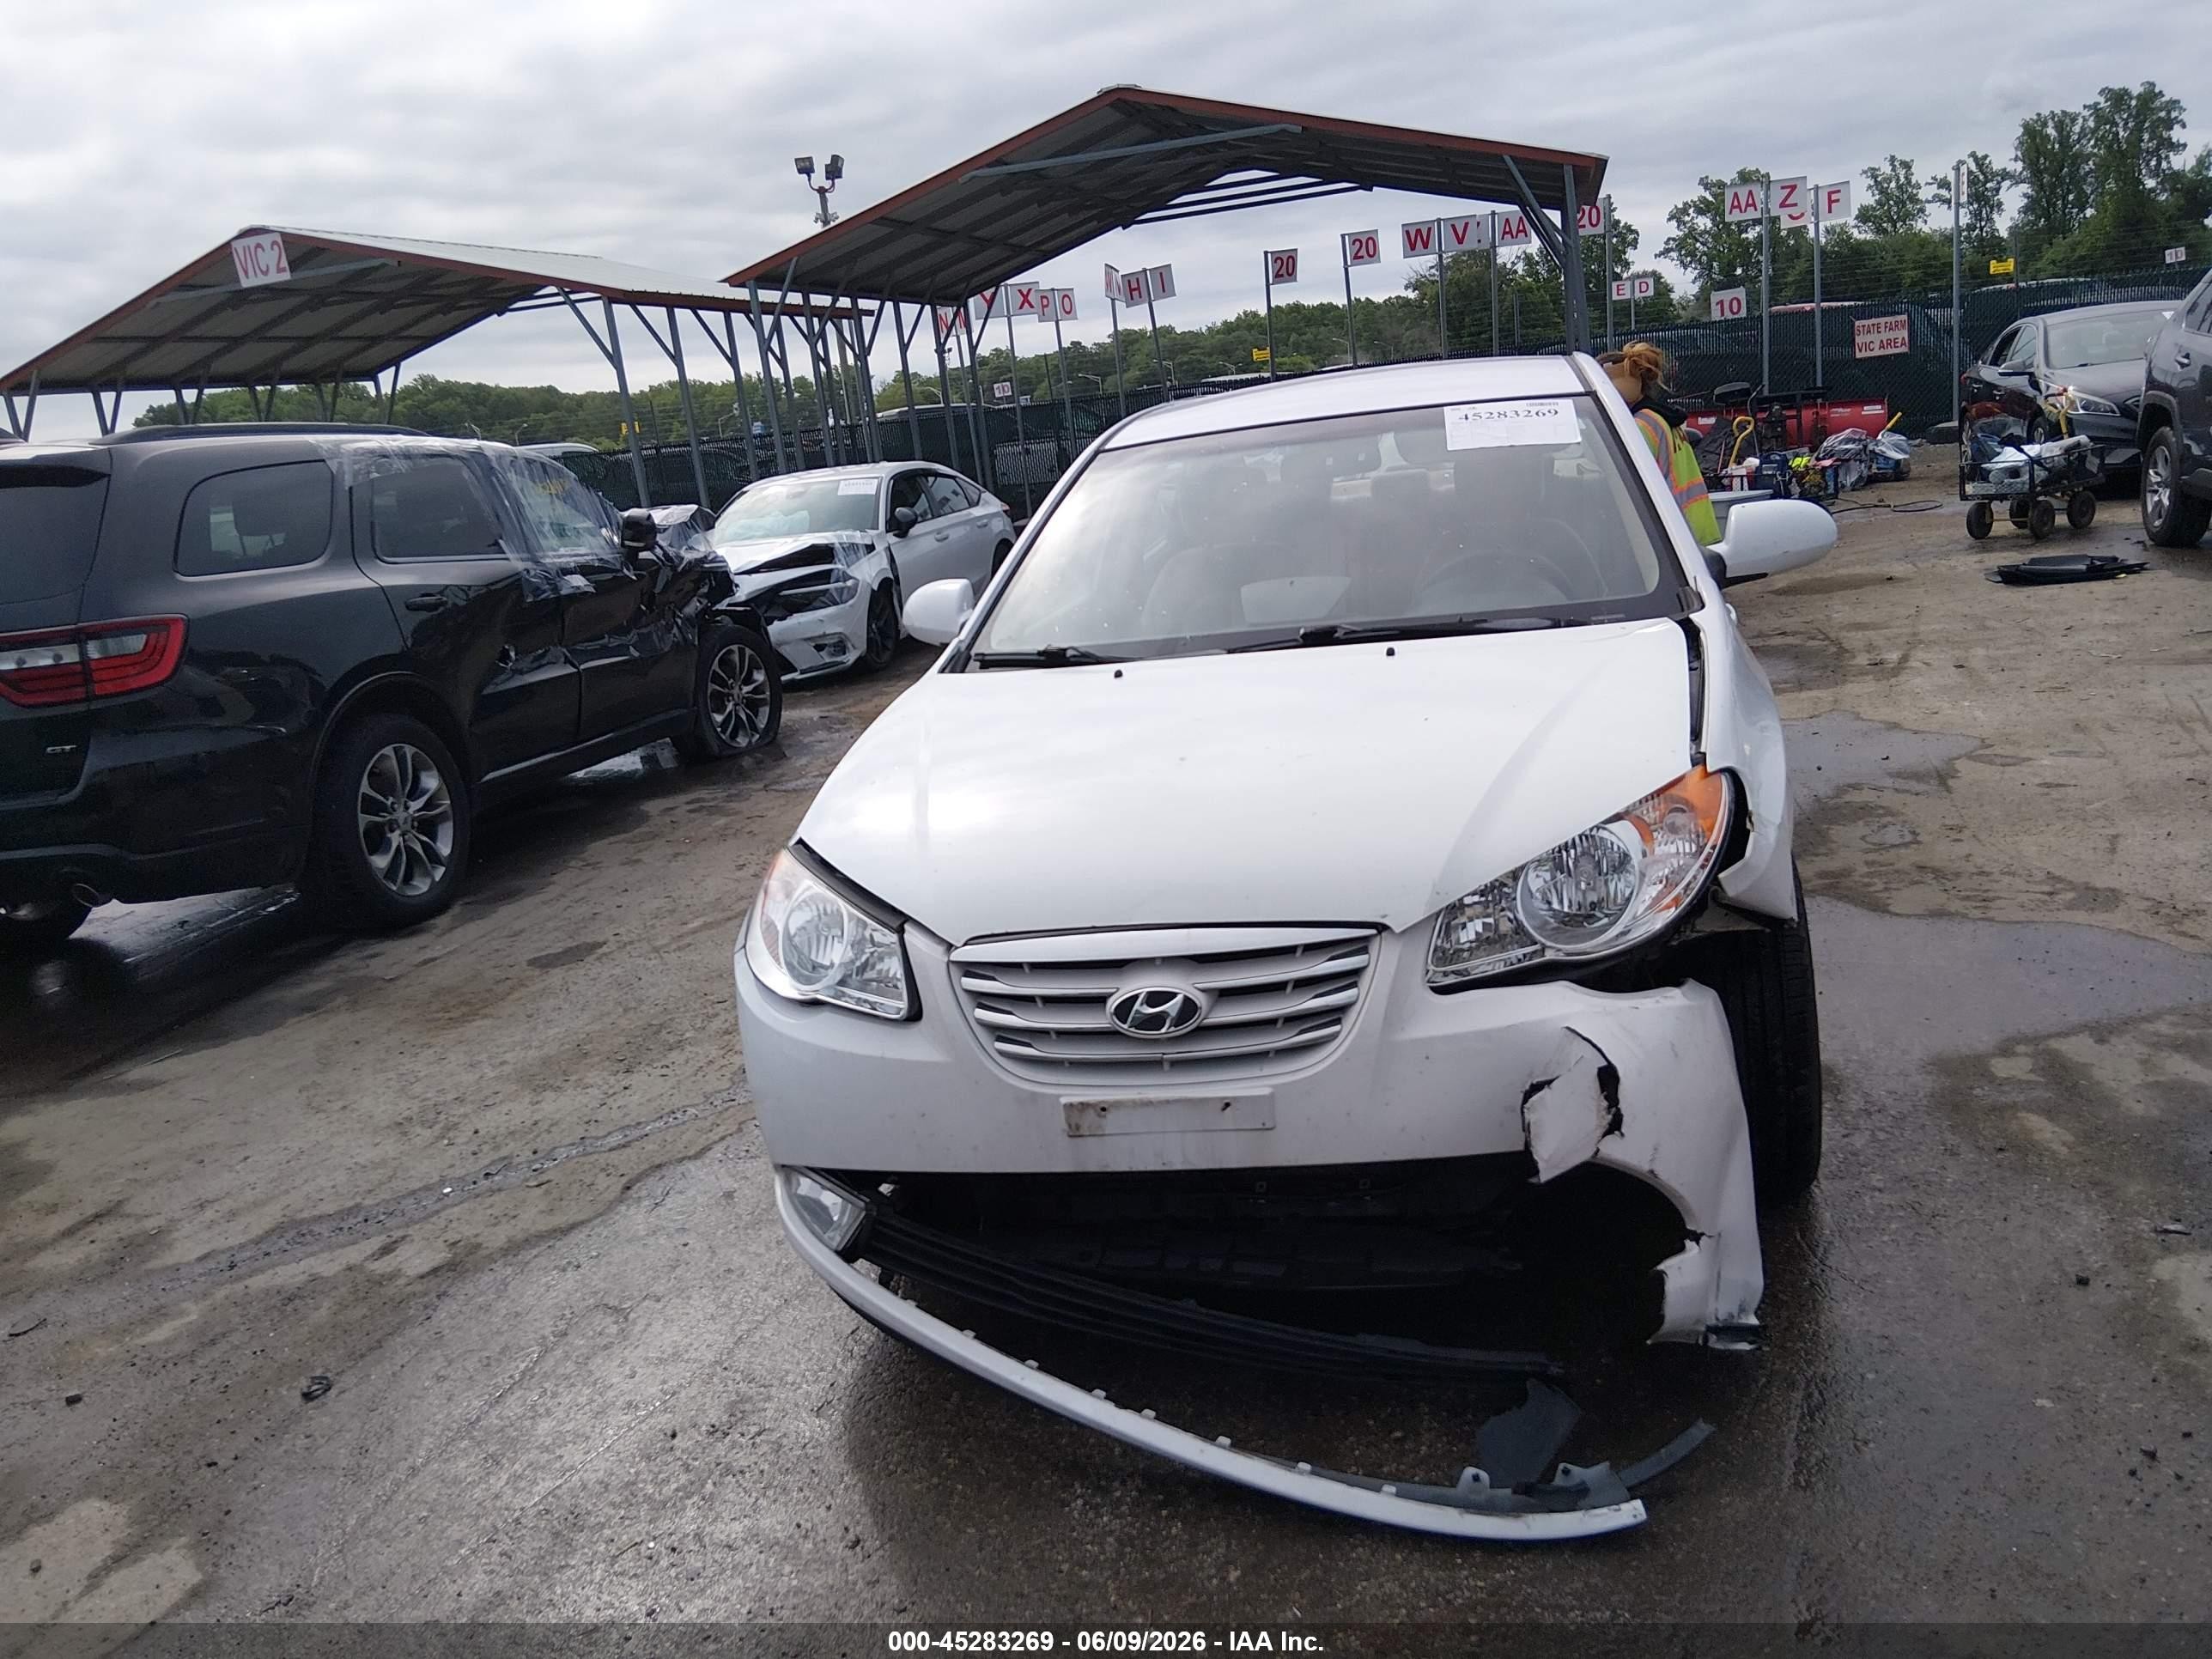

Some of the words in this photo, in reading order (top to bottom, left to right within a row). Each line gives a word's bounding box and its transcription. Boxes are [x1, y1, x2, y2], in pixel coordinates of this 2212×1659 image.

[1729, 189, 1759, 215] AA
[1778, 184, 1799, 209] Z
[1826, 189, 1842, 214] F
[1500, 216, 1528, 241] AA
[1577, 205, 1601, 229] 20
[1405, 226, 1432, 252] W
[1450, 222, 1470, 246] V
[234, 242, 270, 280] VIC
[270, 240, 288, 274] 2
[1351, 236, 1377, 260] 20
[1273, 255, 1296, 279] 20
[1127, 276, 1143, 301] H
[1158, 271, 1166, 294] I
[1615, 283, 1626, 296] E
[1638, 281, 1650, 294] D
[1017, 288, 1036, 310] X
[1040, 295, 1050, 317] P
[1715, 296, 1742, 318] 10
[1856, 322, 1882, 337] STATE
[1883, 319, 1907, 333] FARM
[1856, 340, 1875, 353] VIC
[1878, 336, 1907, 351] AREA
[1458, 408, 1559, 422] 45283269
